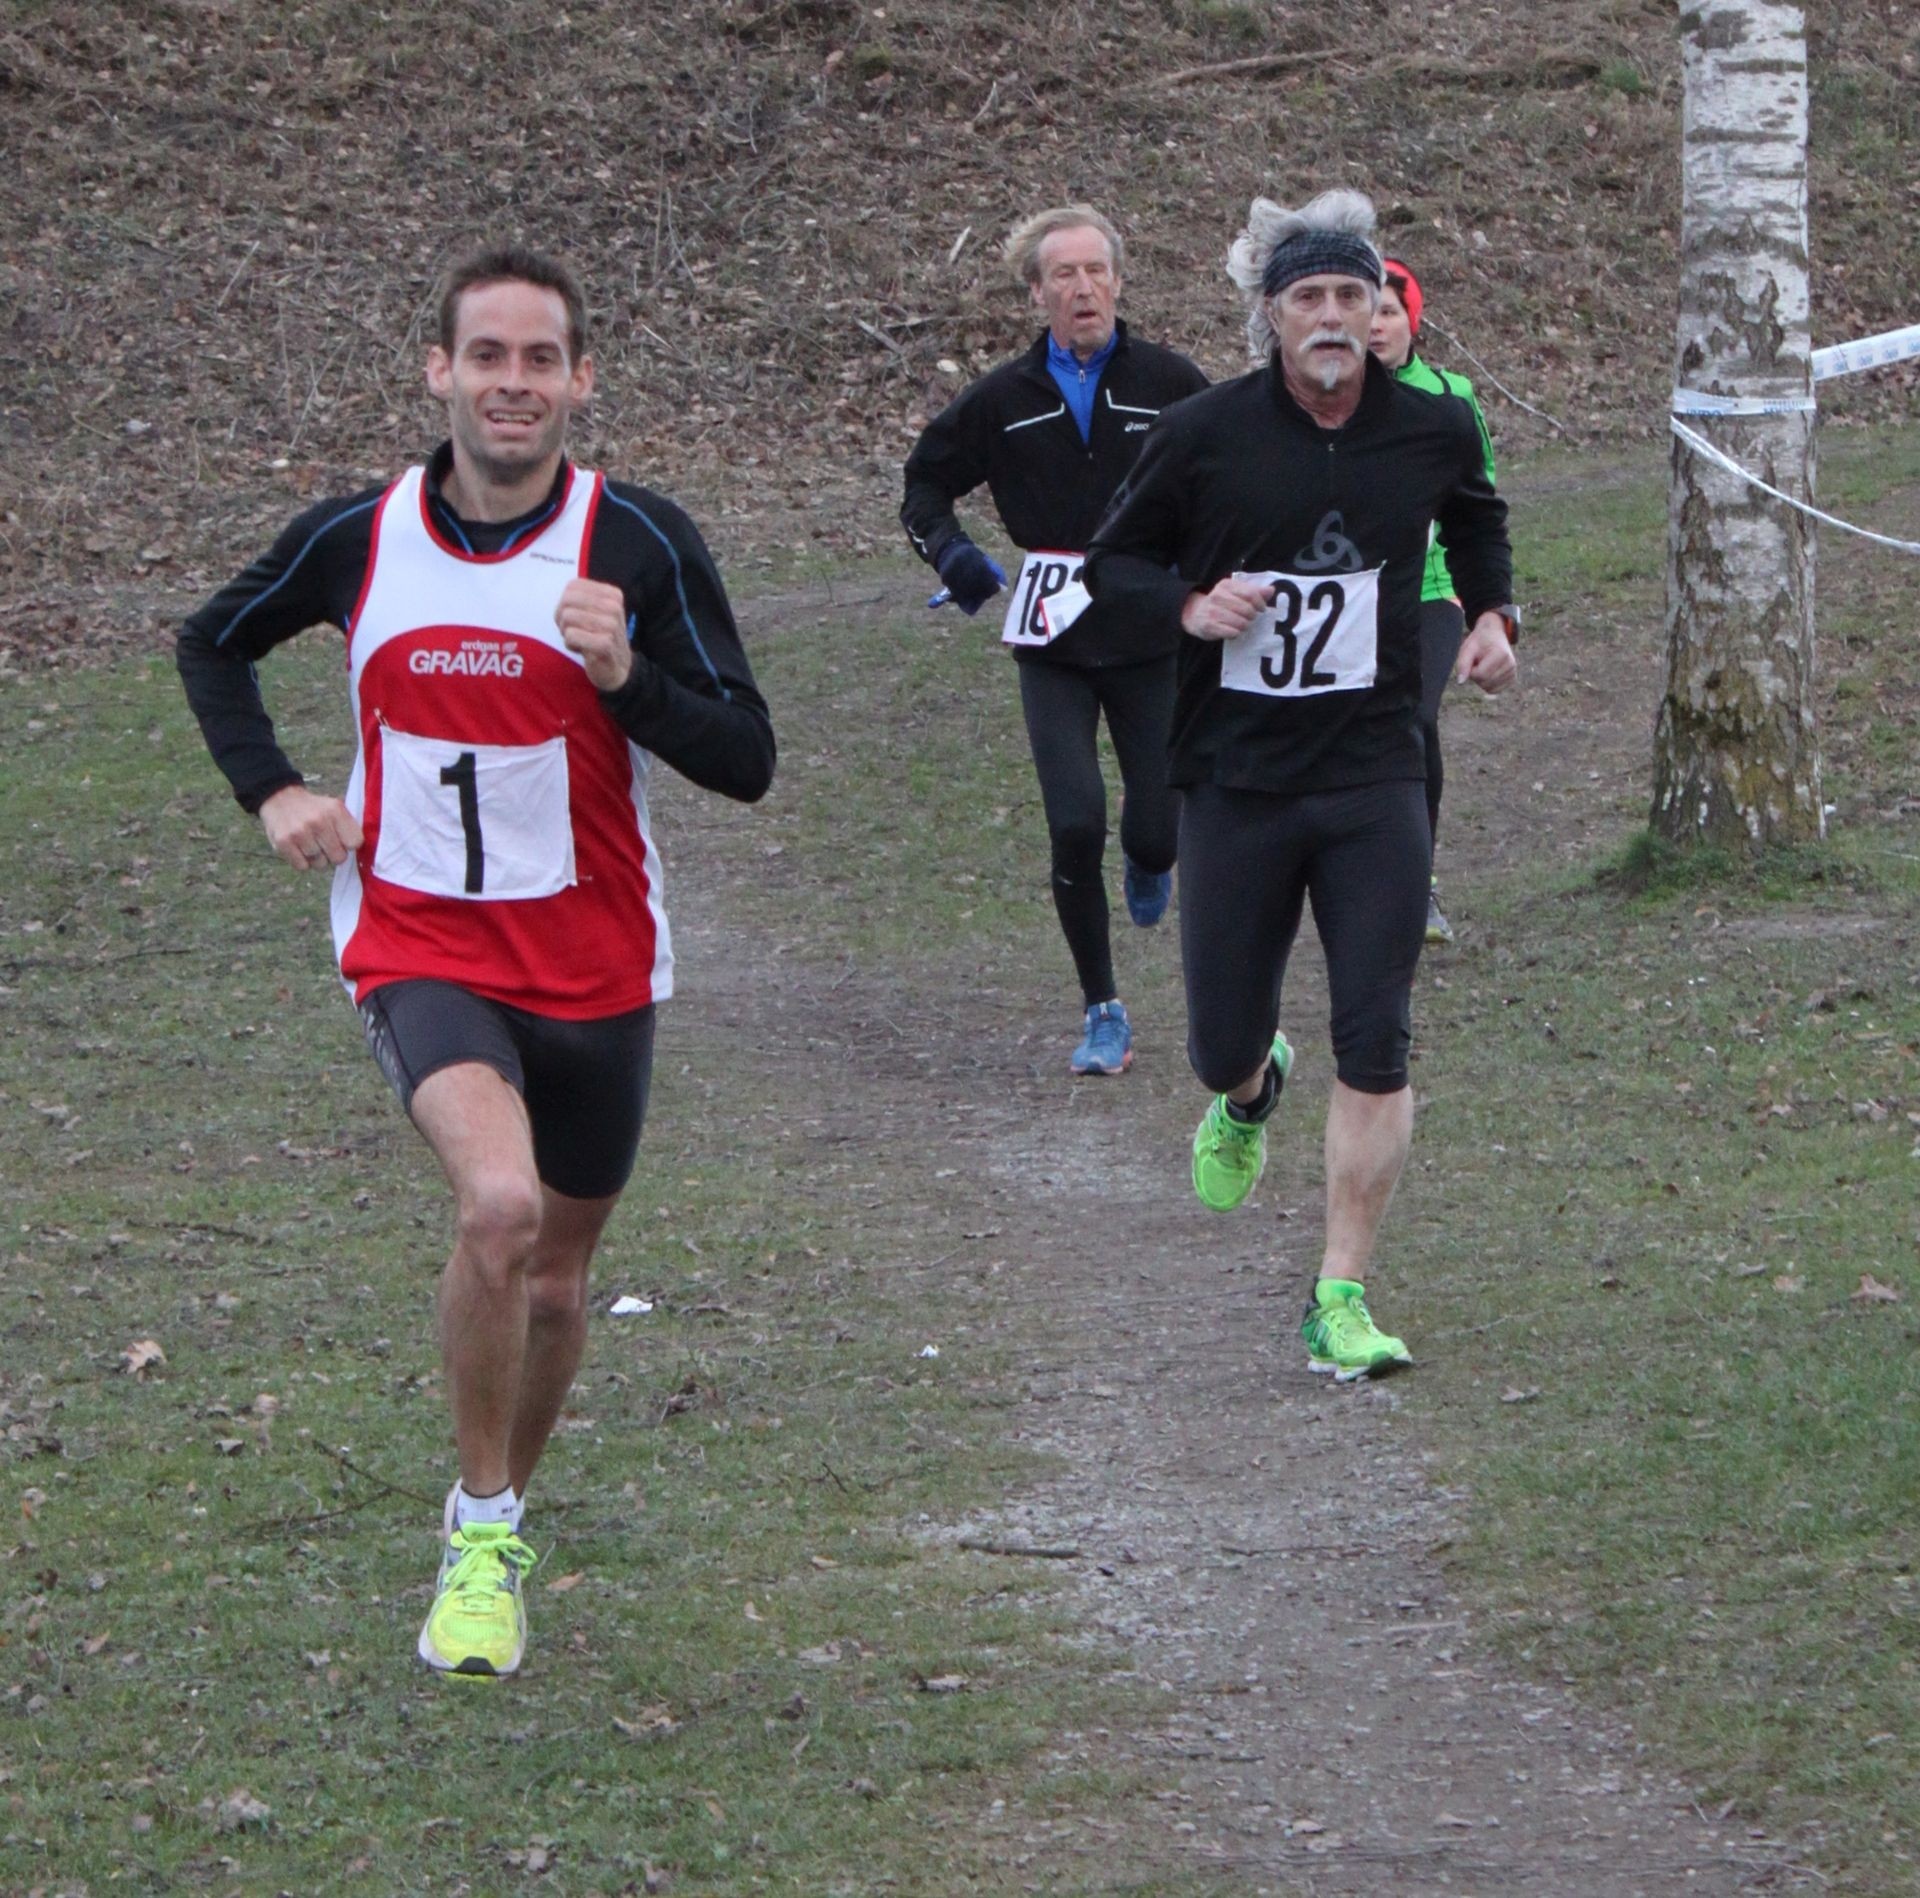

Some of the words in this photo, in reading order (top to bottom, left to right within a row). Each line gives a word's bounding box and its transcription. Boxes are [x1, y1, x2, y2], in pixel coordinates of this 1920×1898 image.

[1018, 561, 1085, 637] 18
[1260, 579, 1345, 689] 32
[409, 649, 524, 678] GRAVAG
[440, 752, 484, 893] 1
